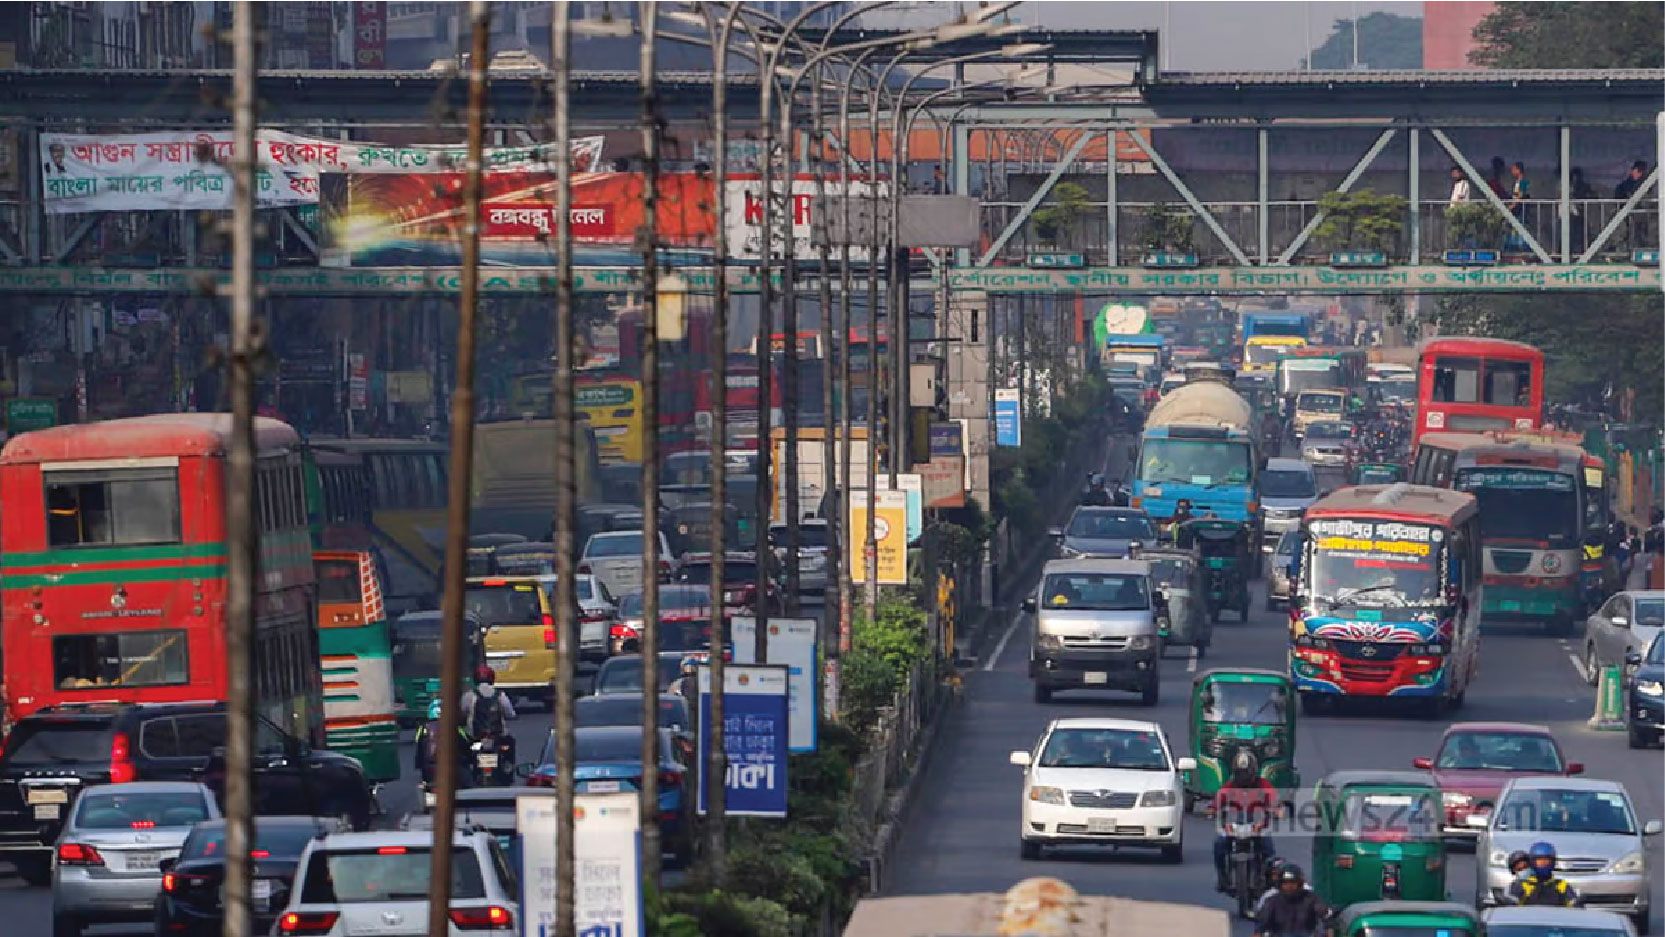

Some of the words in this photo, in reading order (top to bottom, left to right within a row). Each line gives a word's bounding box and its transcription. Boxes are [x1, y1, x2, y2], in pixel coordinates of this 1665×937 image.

[70, 141, 138, 166] আগুন
[269, 140, 348, 171] হুংকার,
[46, 177, 97, 197] বাংলা
[104, 174, 164, 194] মায়ের
[172, 170, 224, 194] পবিত্র
[490, 208, 551, 234] বঙ্গবন্ধু
[943, 270, 1058, 288] র্পোরেশন,
[1141, 272, 1220, 286] সরকার
[1418, 271, 1437, 285] ও
[1552, 268, 1641, 285] পরিবেশ
[725, 763, 775, 790] াকা
